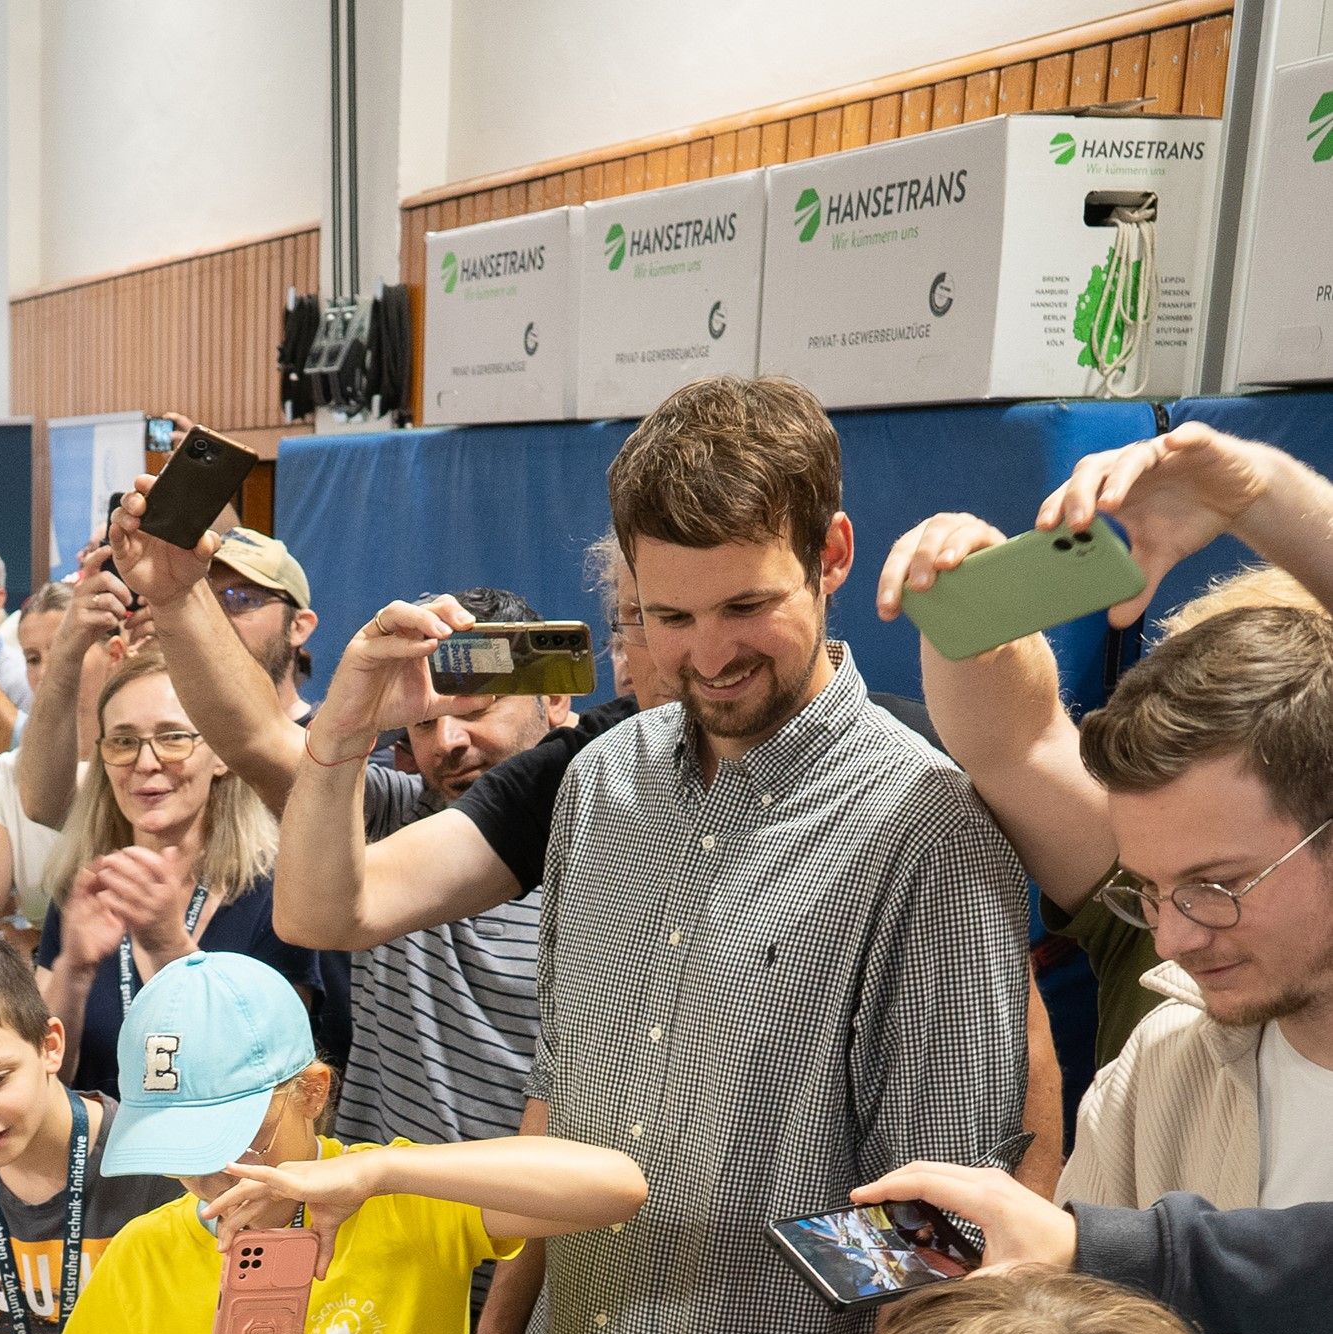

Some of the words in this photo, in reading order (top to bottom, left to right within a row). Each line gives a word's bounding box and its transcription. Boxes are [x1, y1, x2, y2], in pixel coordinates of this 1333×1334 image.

[1081, 139, 1205, 160] HANSETRANS
[1086, 163, 1102, 175] Wir
[1106, 163, 1148, 176] kümmern
[1150, 167, 1165, 176] uns
[826, 169, 968, 226] HANSETRANS
[630, 212, 737, 257] HANSETRANS
[832, 233, 849, 250] Wir
[851, 228, 899, 249] kümmern
[900, 226, 919, 240] uns
[460, 245, 545, 282] HANSETRANS
[1160, 276, 1186, 284] LEIPZIG
[808, 334, 840, 349] PRIVAT-
[841, 333, 847, 346] &
[848, 323, 932, 346] GEWERBEUMZÜGE
[1046, 338, 1065, 346] KÖLN
[1155, 339, 1187, 347] MÜNCHEN
[120, 942, 132, 983] Zukunft
[143, 1034, 181, 1092] E
[67, 1135, 88, 1245] Technik-Initiative
[3, 1271, 25, 1324] Zukunft
[62, 1248, 79, 1314] Karlsruher
